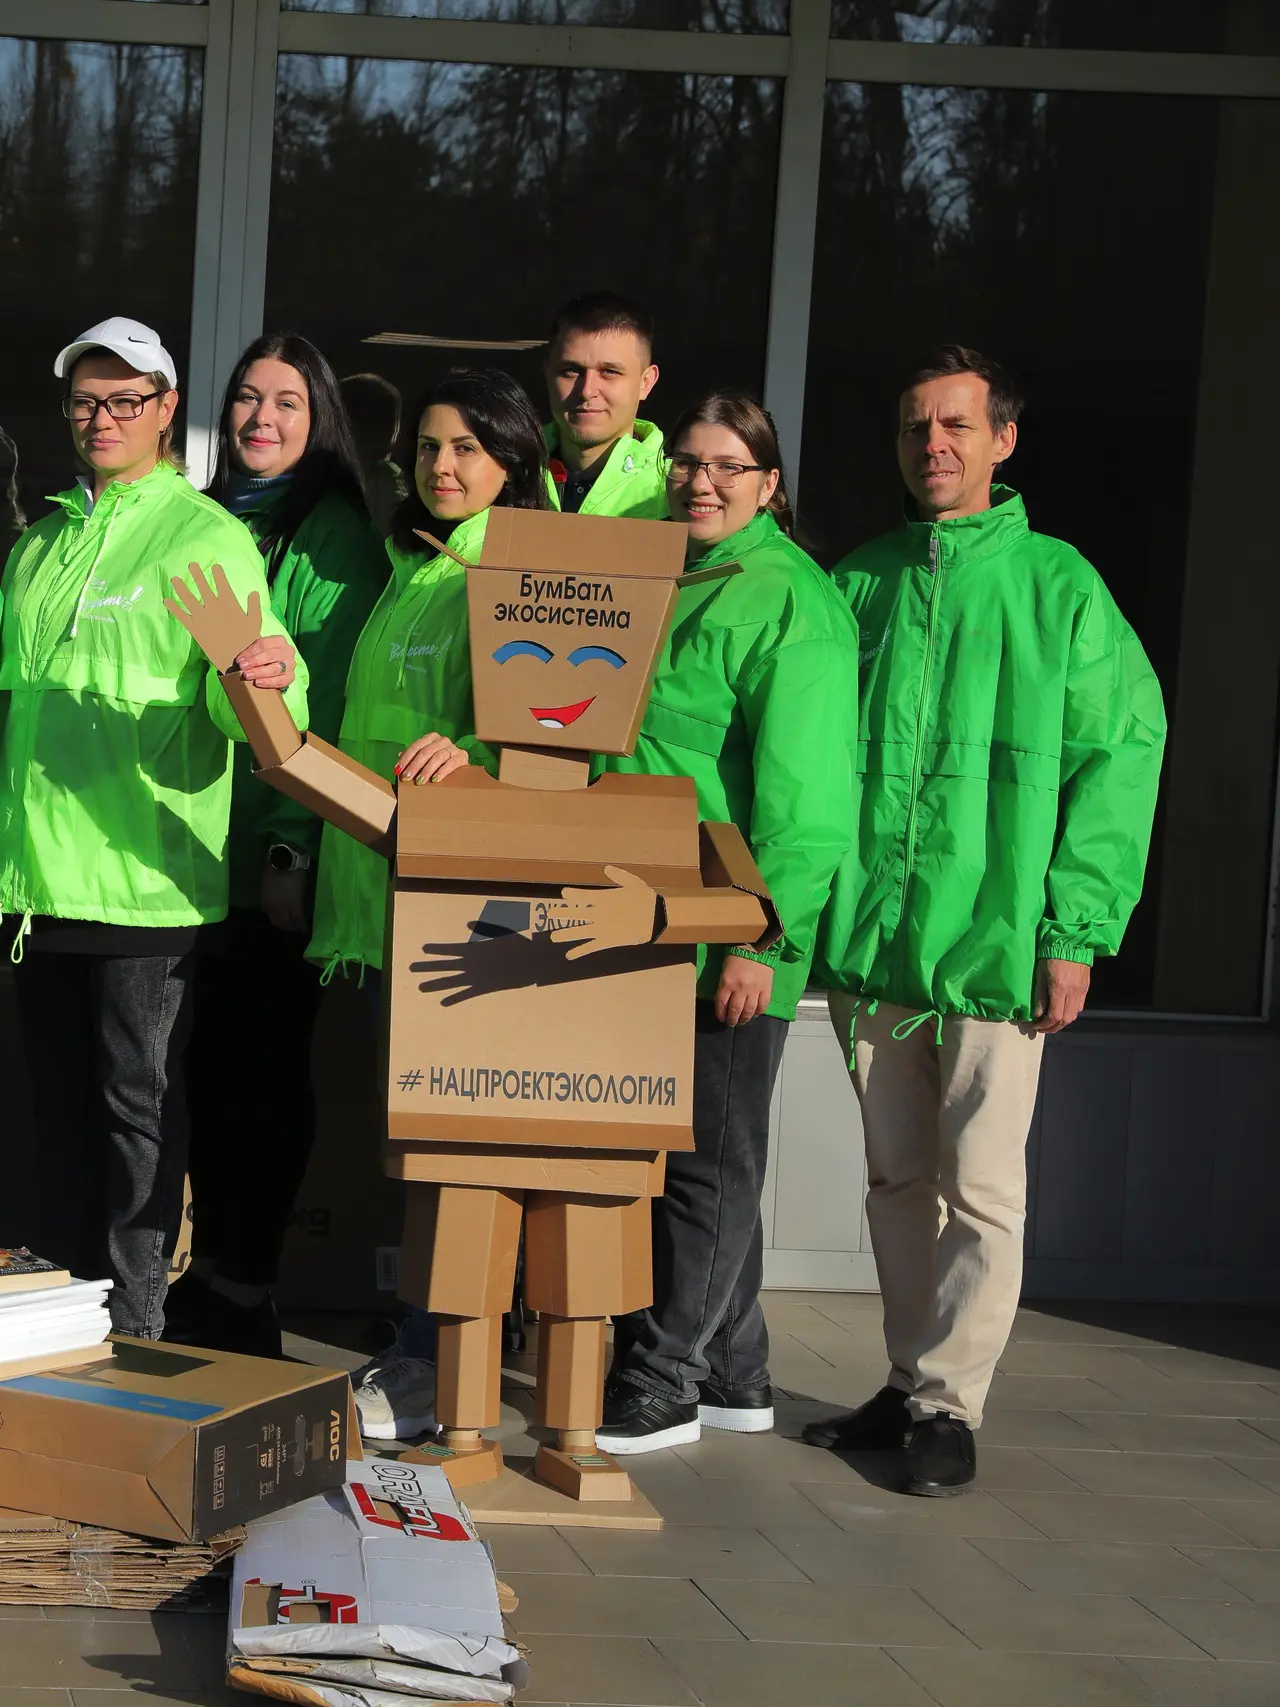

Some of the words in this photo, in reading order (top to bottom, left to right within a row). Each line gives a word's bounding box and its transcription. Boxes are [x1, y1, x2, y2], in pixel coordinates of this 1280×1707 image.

[519, 574, 614, 603] БумБатл
[494, 602, 631, 630] экосистема
[329, 1409, 340, 1462] AOC
